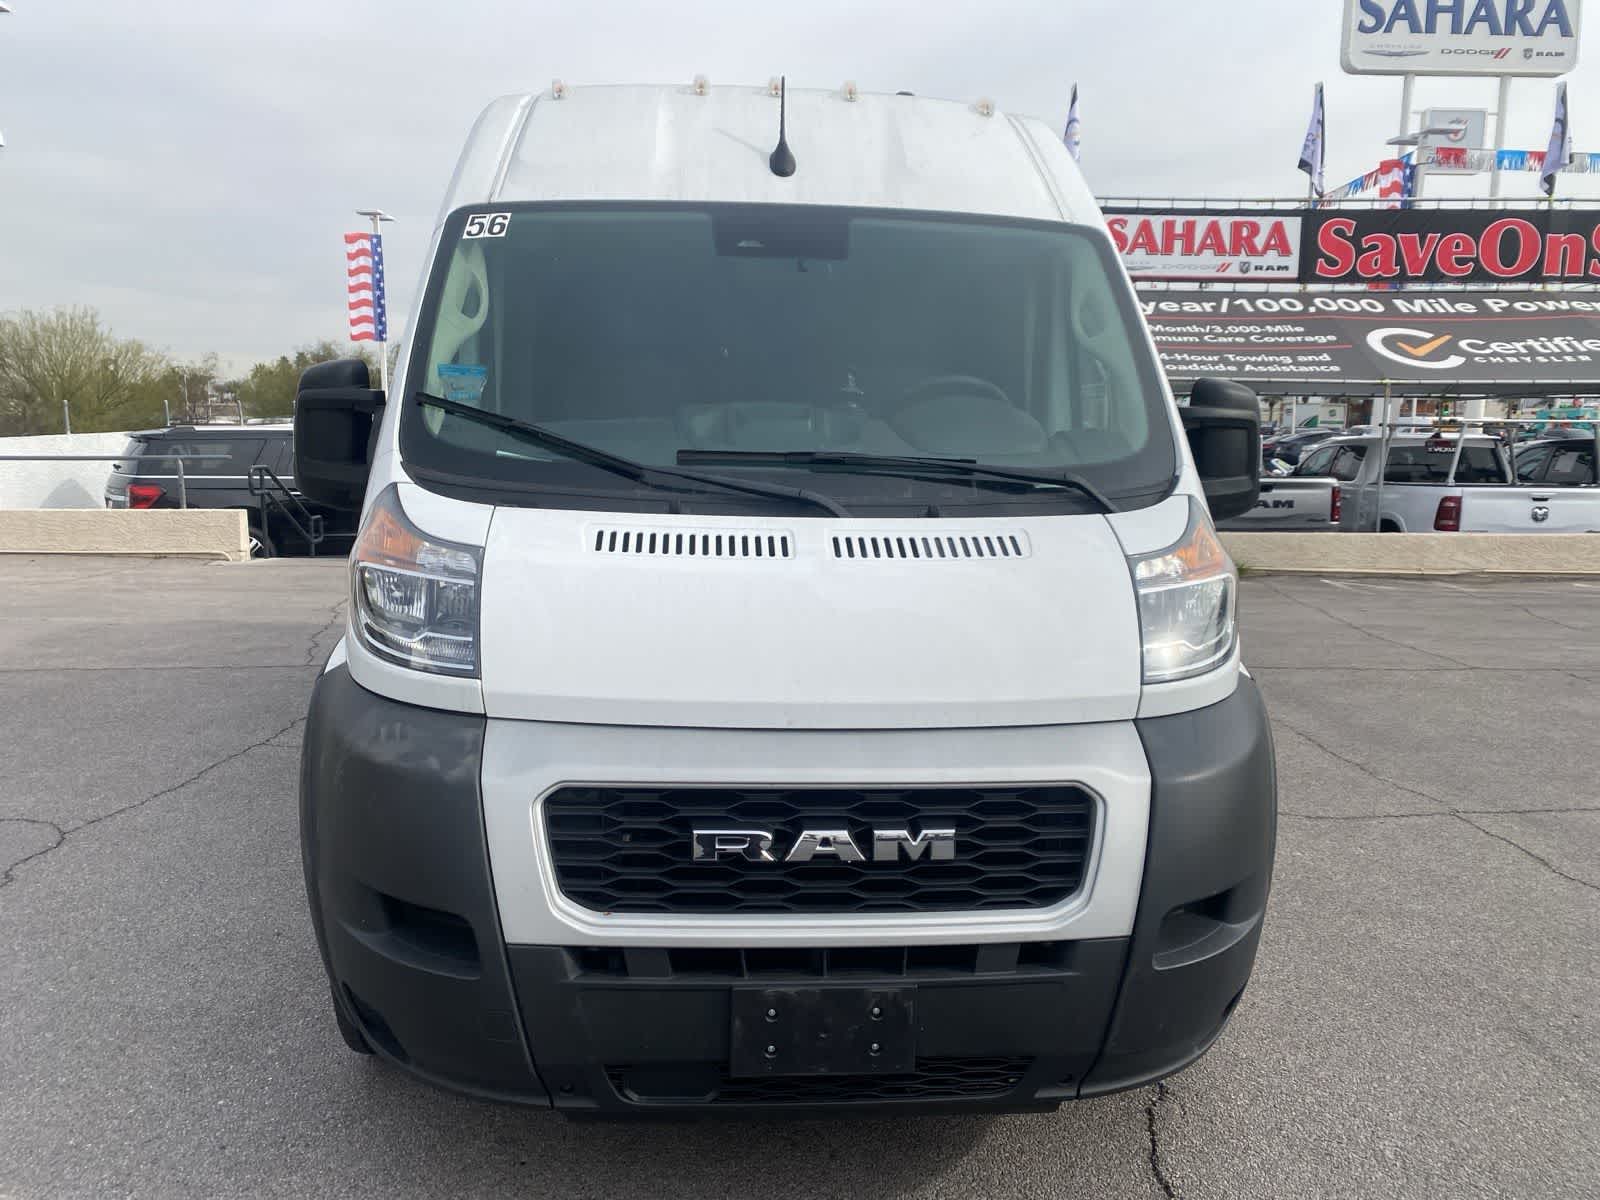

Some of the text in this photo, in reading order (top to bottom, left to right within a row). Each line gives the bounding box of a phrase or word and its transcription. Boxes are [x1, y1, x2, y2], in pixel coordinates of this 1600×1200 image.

[1357, 0, 1575, 38] SAHARA
[465, 215, 508, 237] 56
[1106, 217, 1294, 257] SAHARA
[1315, 217, 1600, 278] SaveOn
[1254, 264, 1289, 272] RAM
[1392, 298, 1477, 313] Mile
[1203, 334, 1246, 343] Care
[1250, 334, 1338, 344] Coverage
[1224, 354, 1293, 364] Towing
[1297, 353, 1332, 362] and
[1163, 363, 1341, 373] oadside Assistance
[692, 829, 956, 862] RAM
